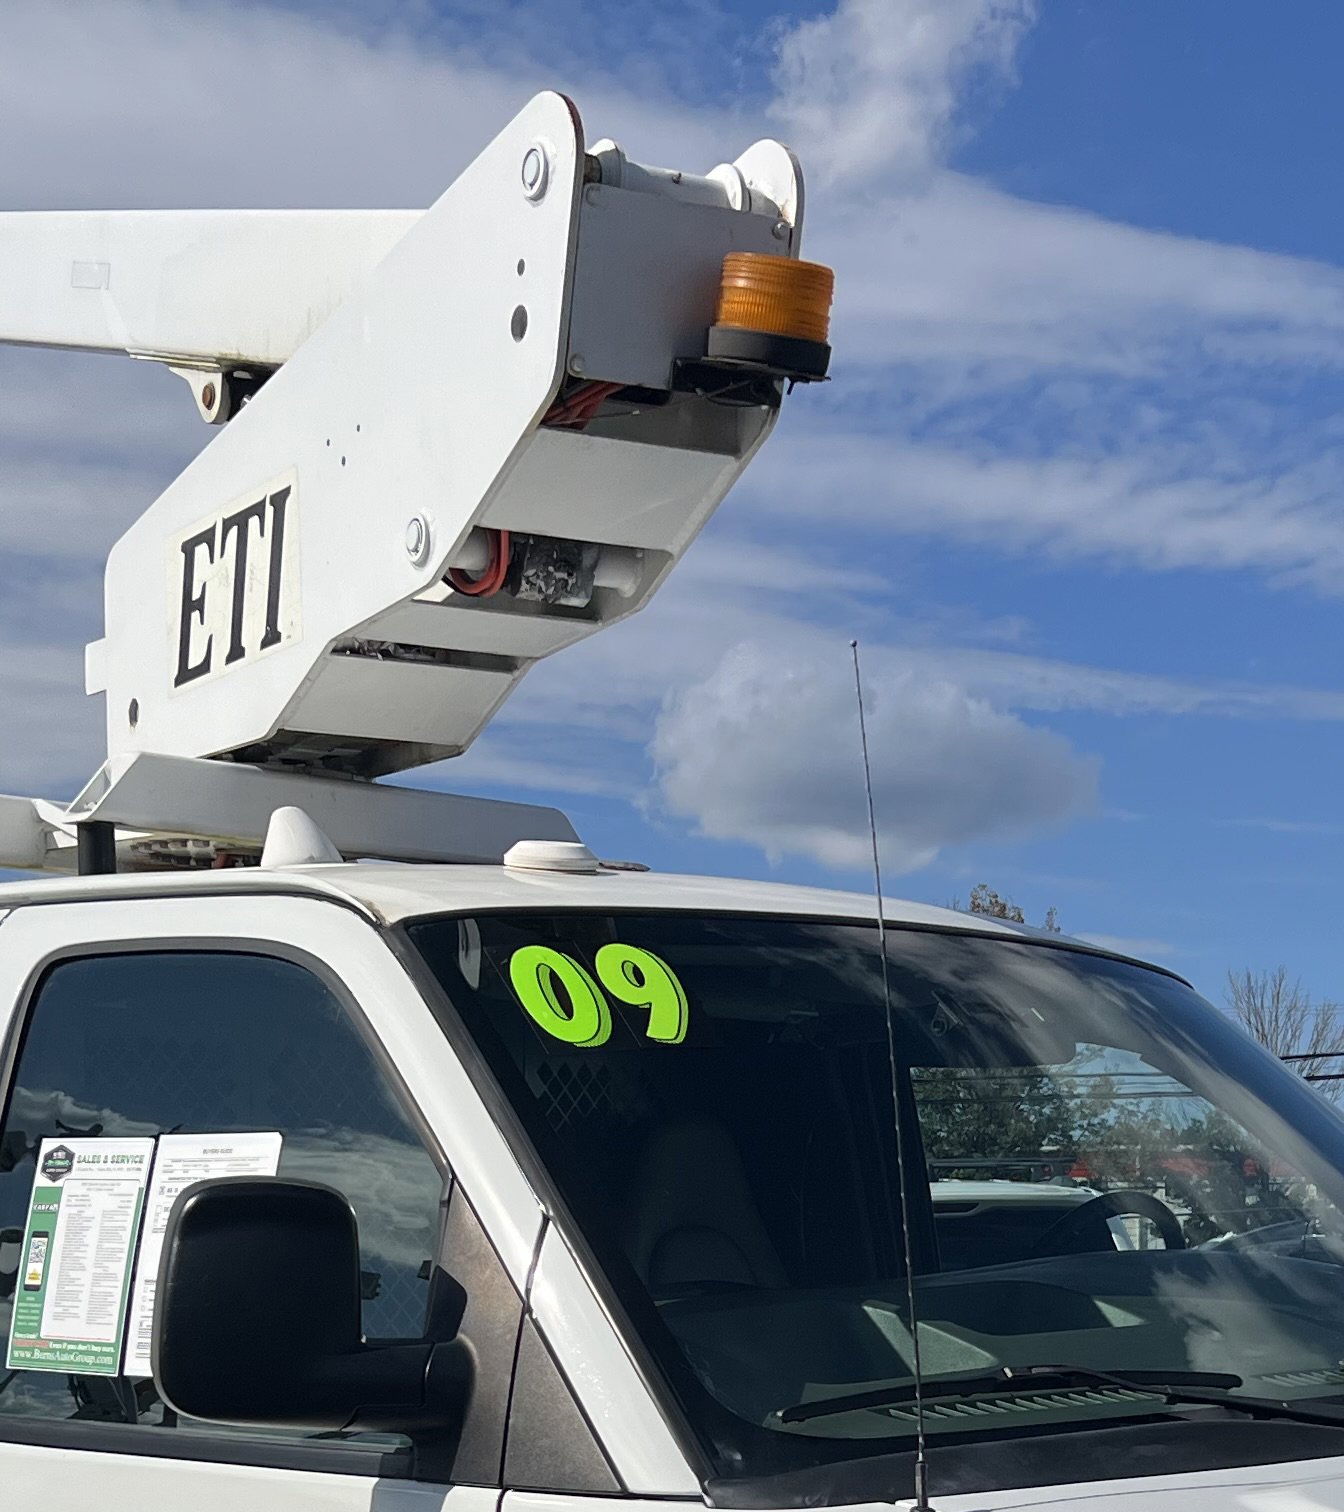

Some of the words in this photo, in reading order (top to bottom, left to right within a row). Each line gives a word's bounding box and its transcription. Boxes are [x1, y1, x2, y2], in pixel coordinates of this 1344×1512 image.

[174, 485, 292, 688] ETI
[509, 943, 689, 1048] 09
[76, 1154, 101, 1164] SALES
[110, 1154, 146, 1164] SERVICE
